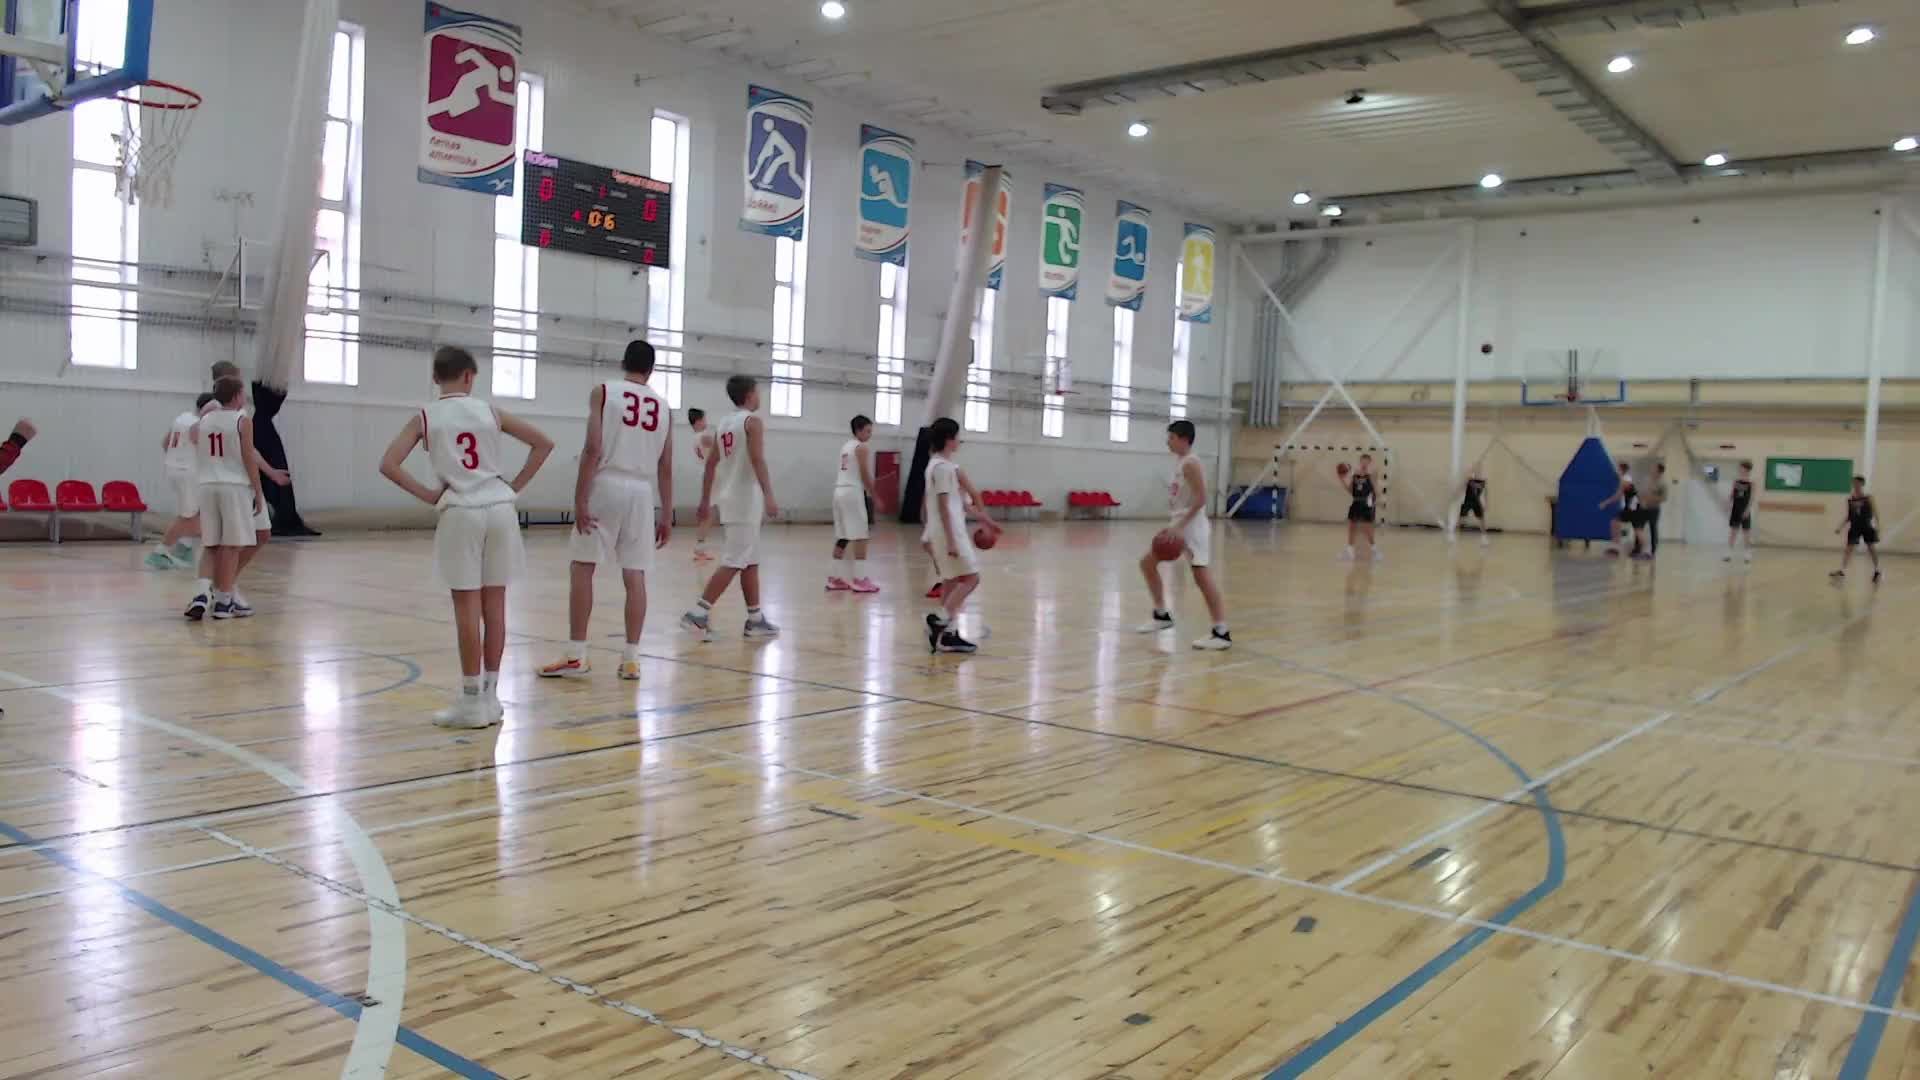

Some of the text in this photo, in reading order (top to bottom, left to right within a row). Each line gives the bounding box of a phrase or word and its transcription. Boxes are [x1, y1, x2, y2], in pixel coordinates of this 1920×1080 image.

[622, 391, 659, 431] 33
[208, 432, 224, 456] 11
[456, 432, 479, 470] 3
